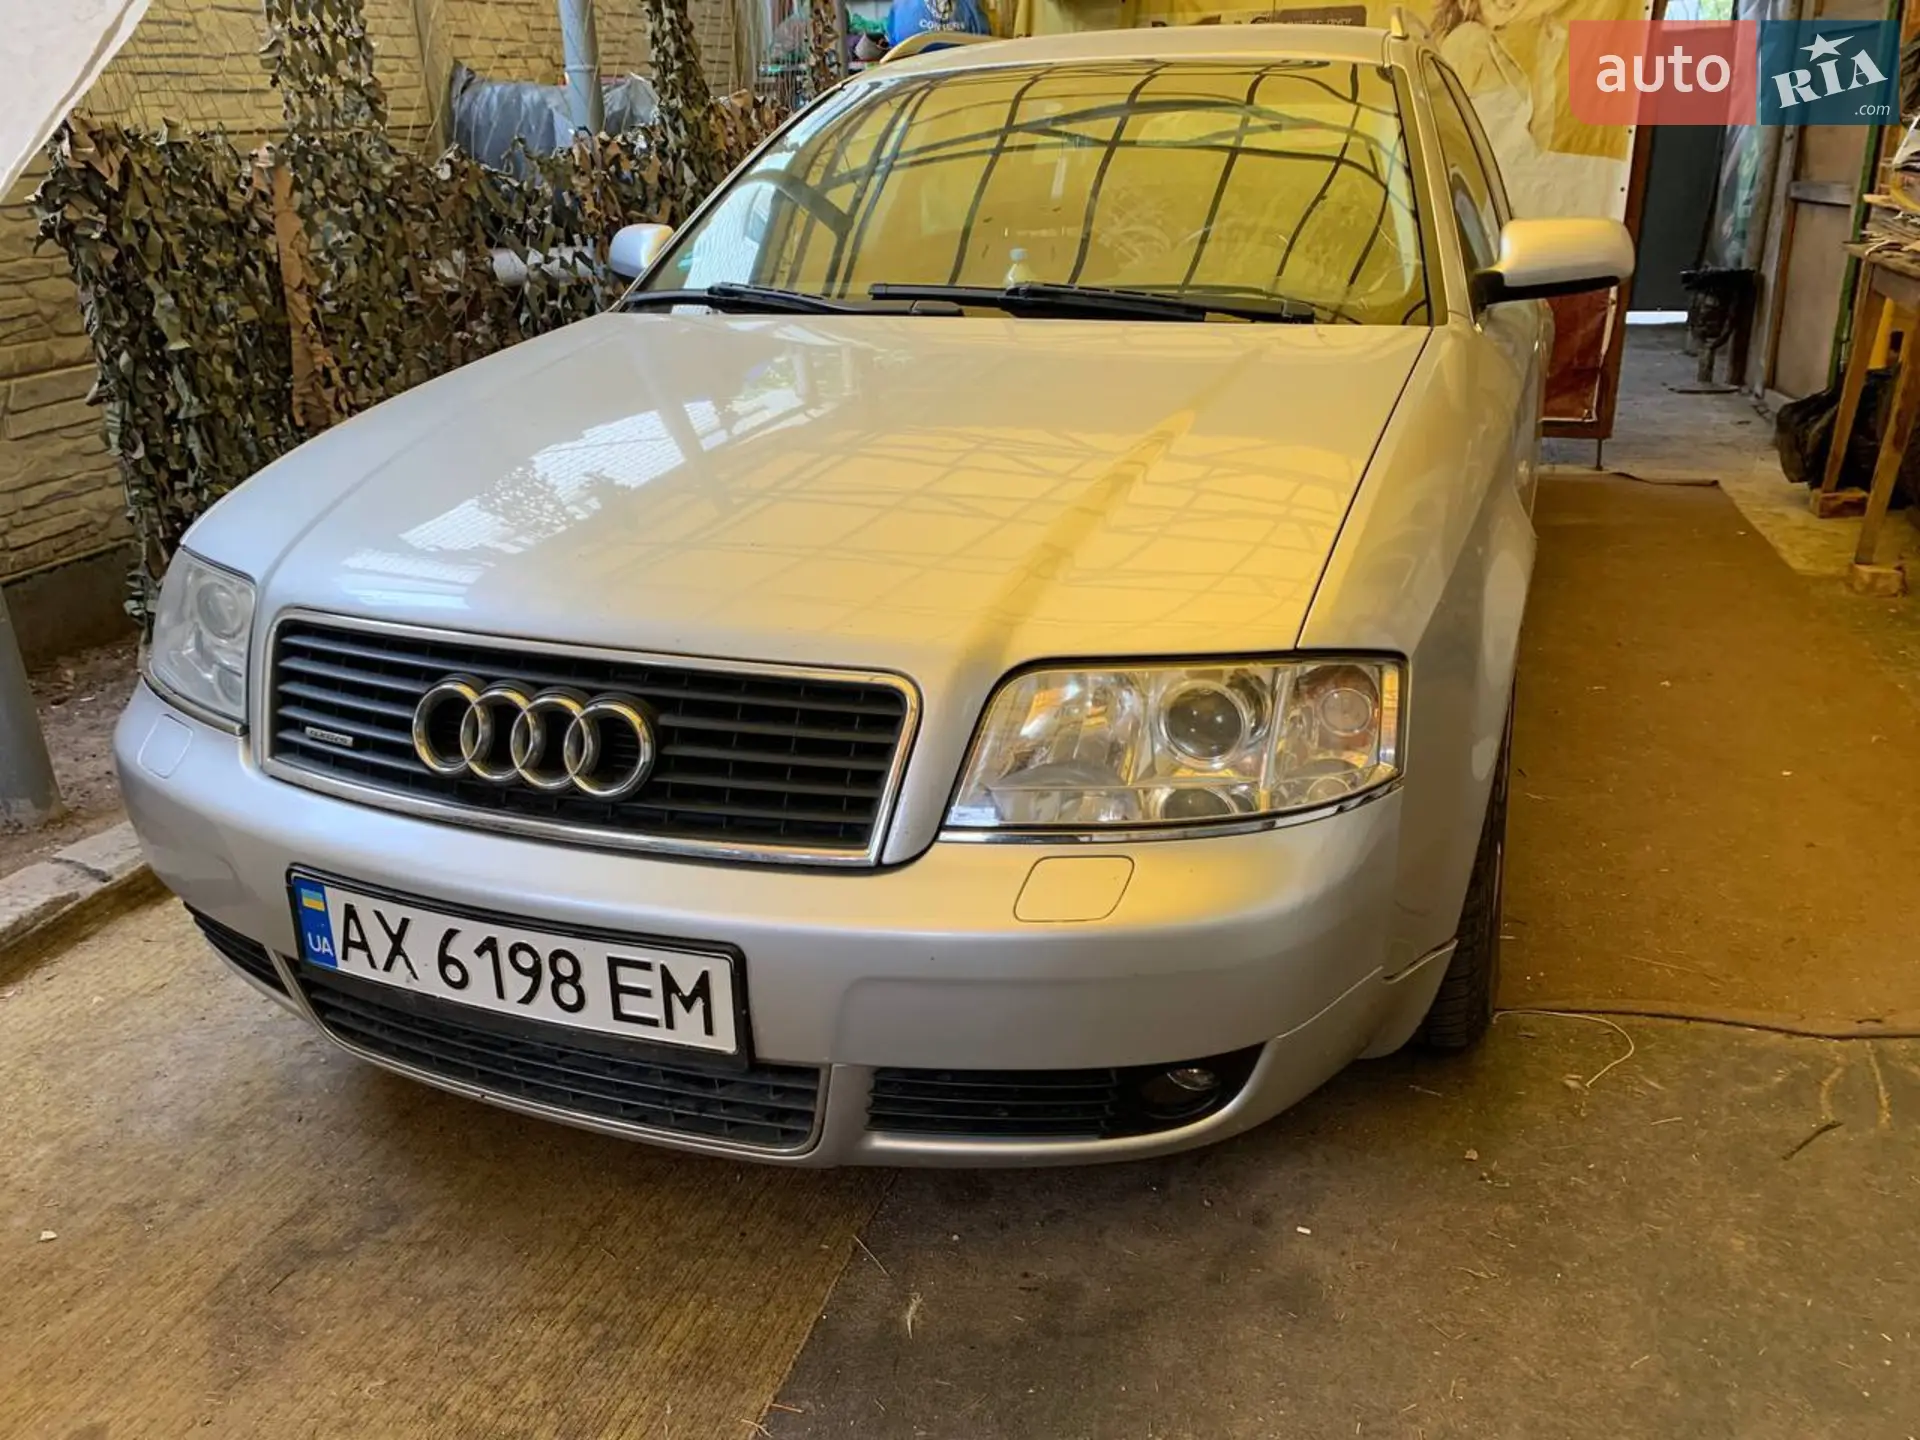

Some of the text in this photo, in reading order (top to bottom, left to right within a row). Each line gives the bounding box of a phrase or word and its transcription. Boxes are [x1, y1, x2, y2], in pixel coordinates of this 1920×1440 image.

[308, 931, 334, 957] UA
[341, 902, 714, 1037] AX 6198 EM
